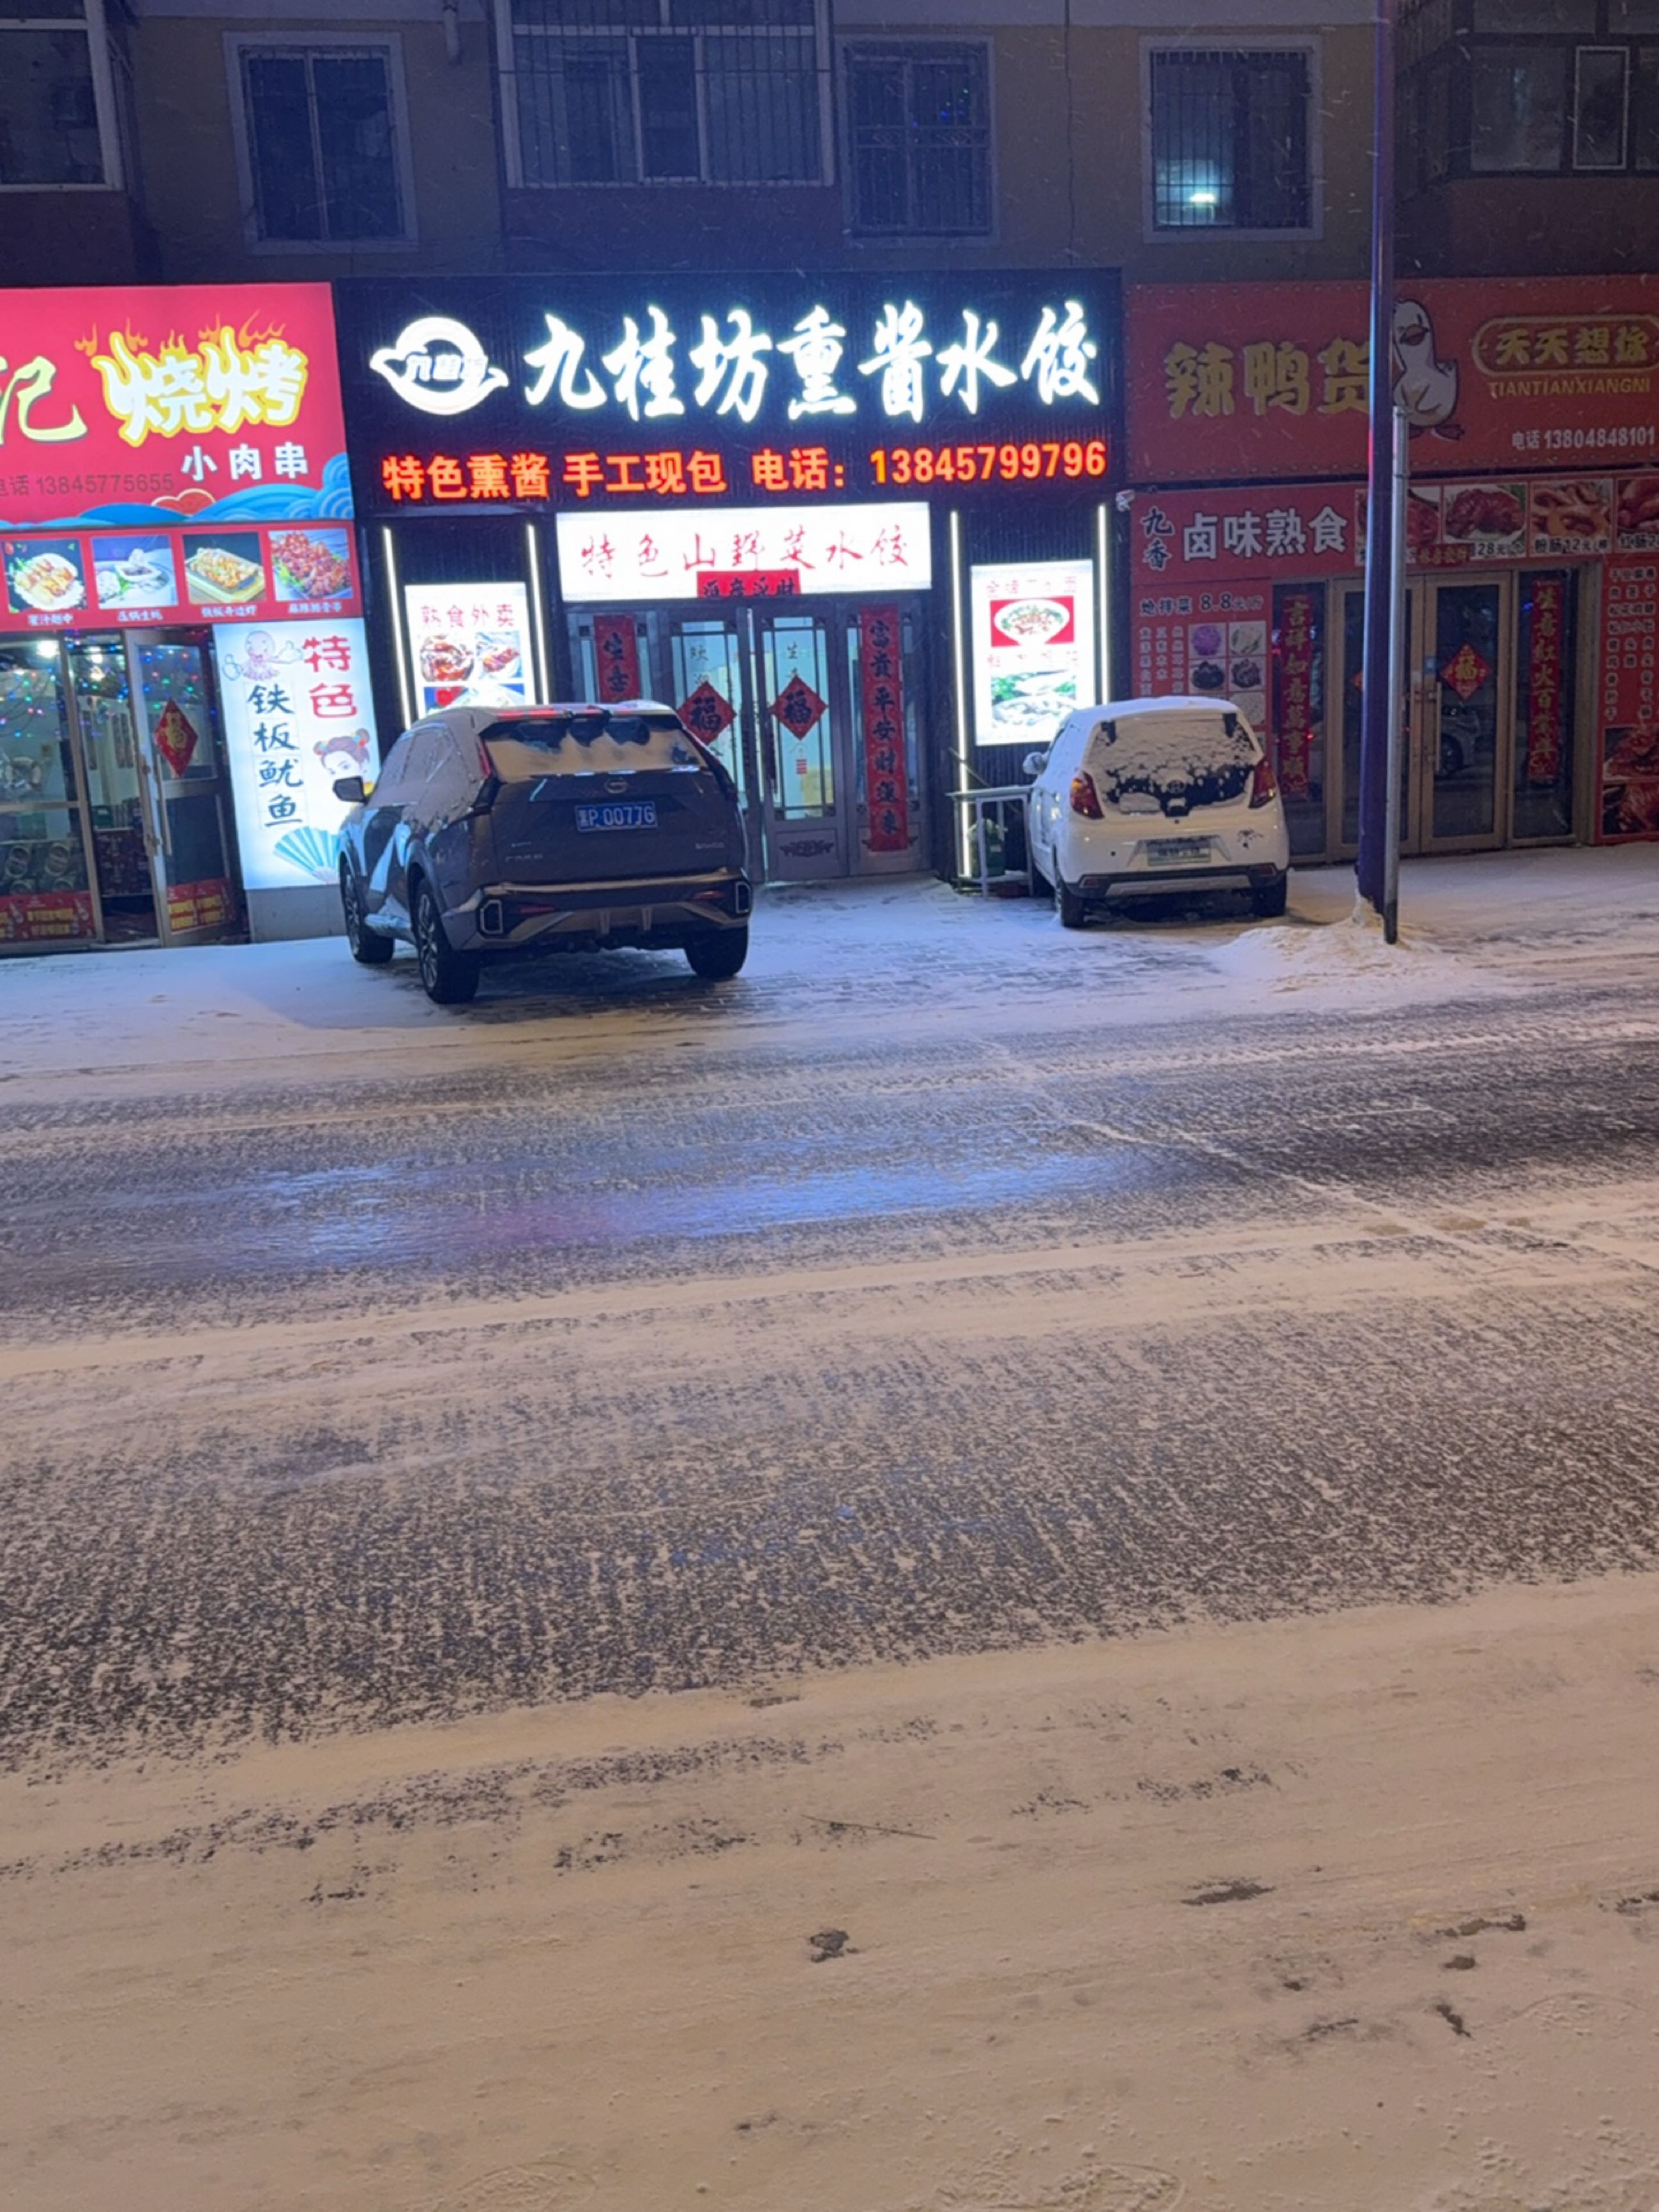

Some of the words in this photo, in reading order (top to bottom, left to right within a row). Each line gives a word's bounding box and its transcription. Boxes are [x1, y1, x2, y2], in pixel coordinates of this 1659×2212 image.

[0, 355, 88, 444] 记
[91, 326, 309, 447] 烧烤
[1488, 377, 1651, 397] TIANTIANXIANGNI
[181, 442, 309, 481] 小肉串
[1512, 429, 1541, 451] 电话
[1544, 426, 1655, 449] 13804848101
[36, 473, 175, 495] 13845775655
[383, 453, 550, 500] 特色熏酱
[563, 450, 727, 497] 手工现包
[870, 441, 1107, 484] 13845799796
[1183, 506, 1347, 562] 卤味熟食
[302, 636, 357, 718] 特色
[689, 696, 723, 730] 福
[247, 683, 304, 827] 铁板鱿鱼
